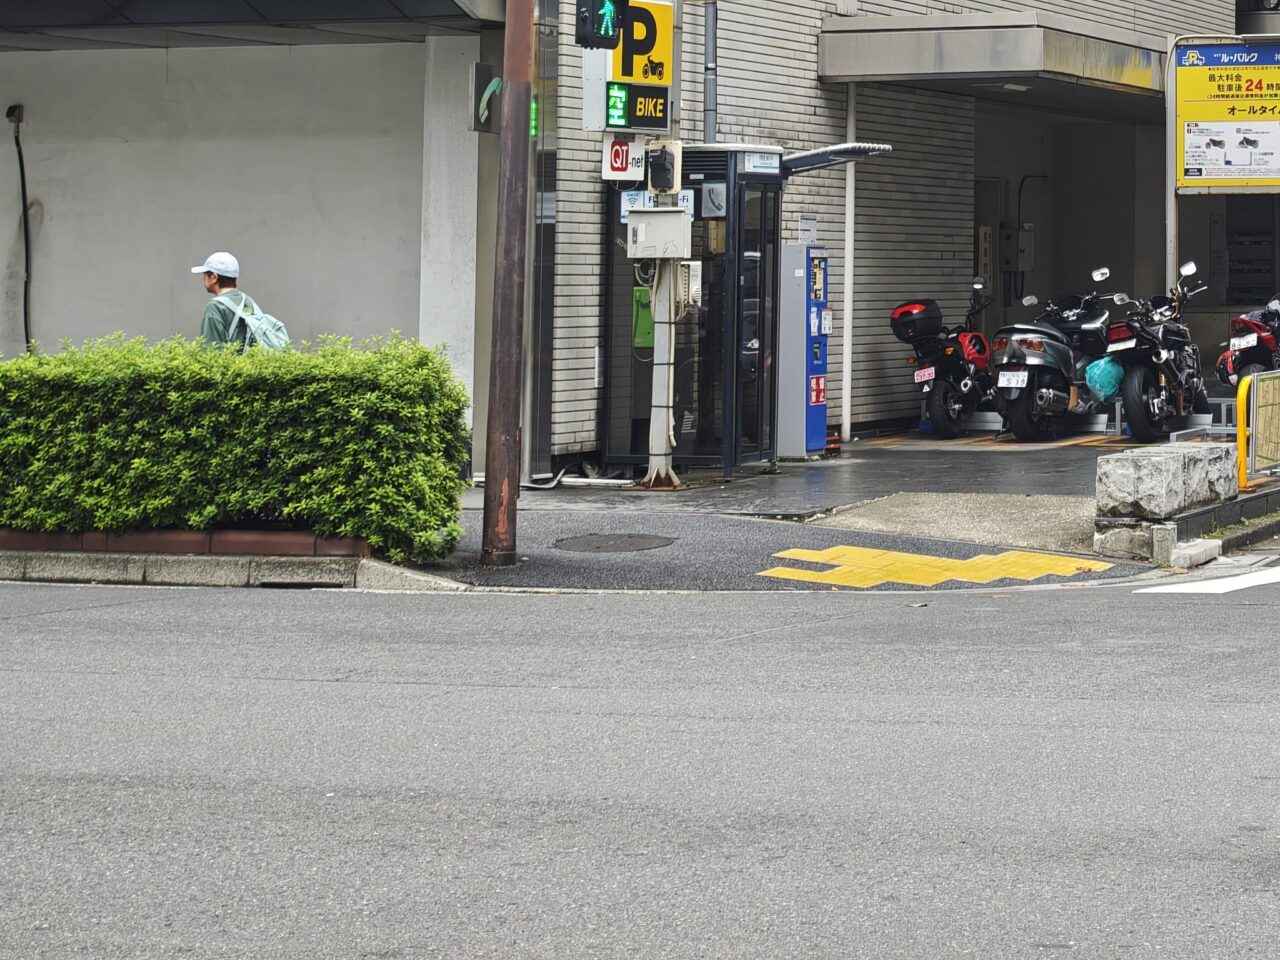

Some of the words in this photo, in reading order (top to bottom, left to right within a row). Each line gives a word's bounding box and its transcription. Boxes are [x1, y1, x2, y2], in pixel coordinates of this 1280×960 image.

[621, 5, 658, 77] P
[1208, 73, 1242, 82] 最大料金
[636, 97, 665, 117] BIKE
